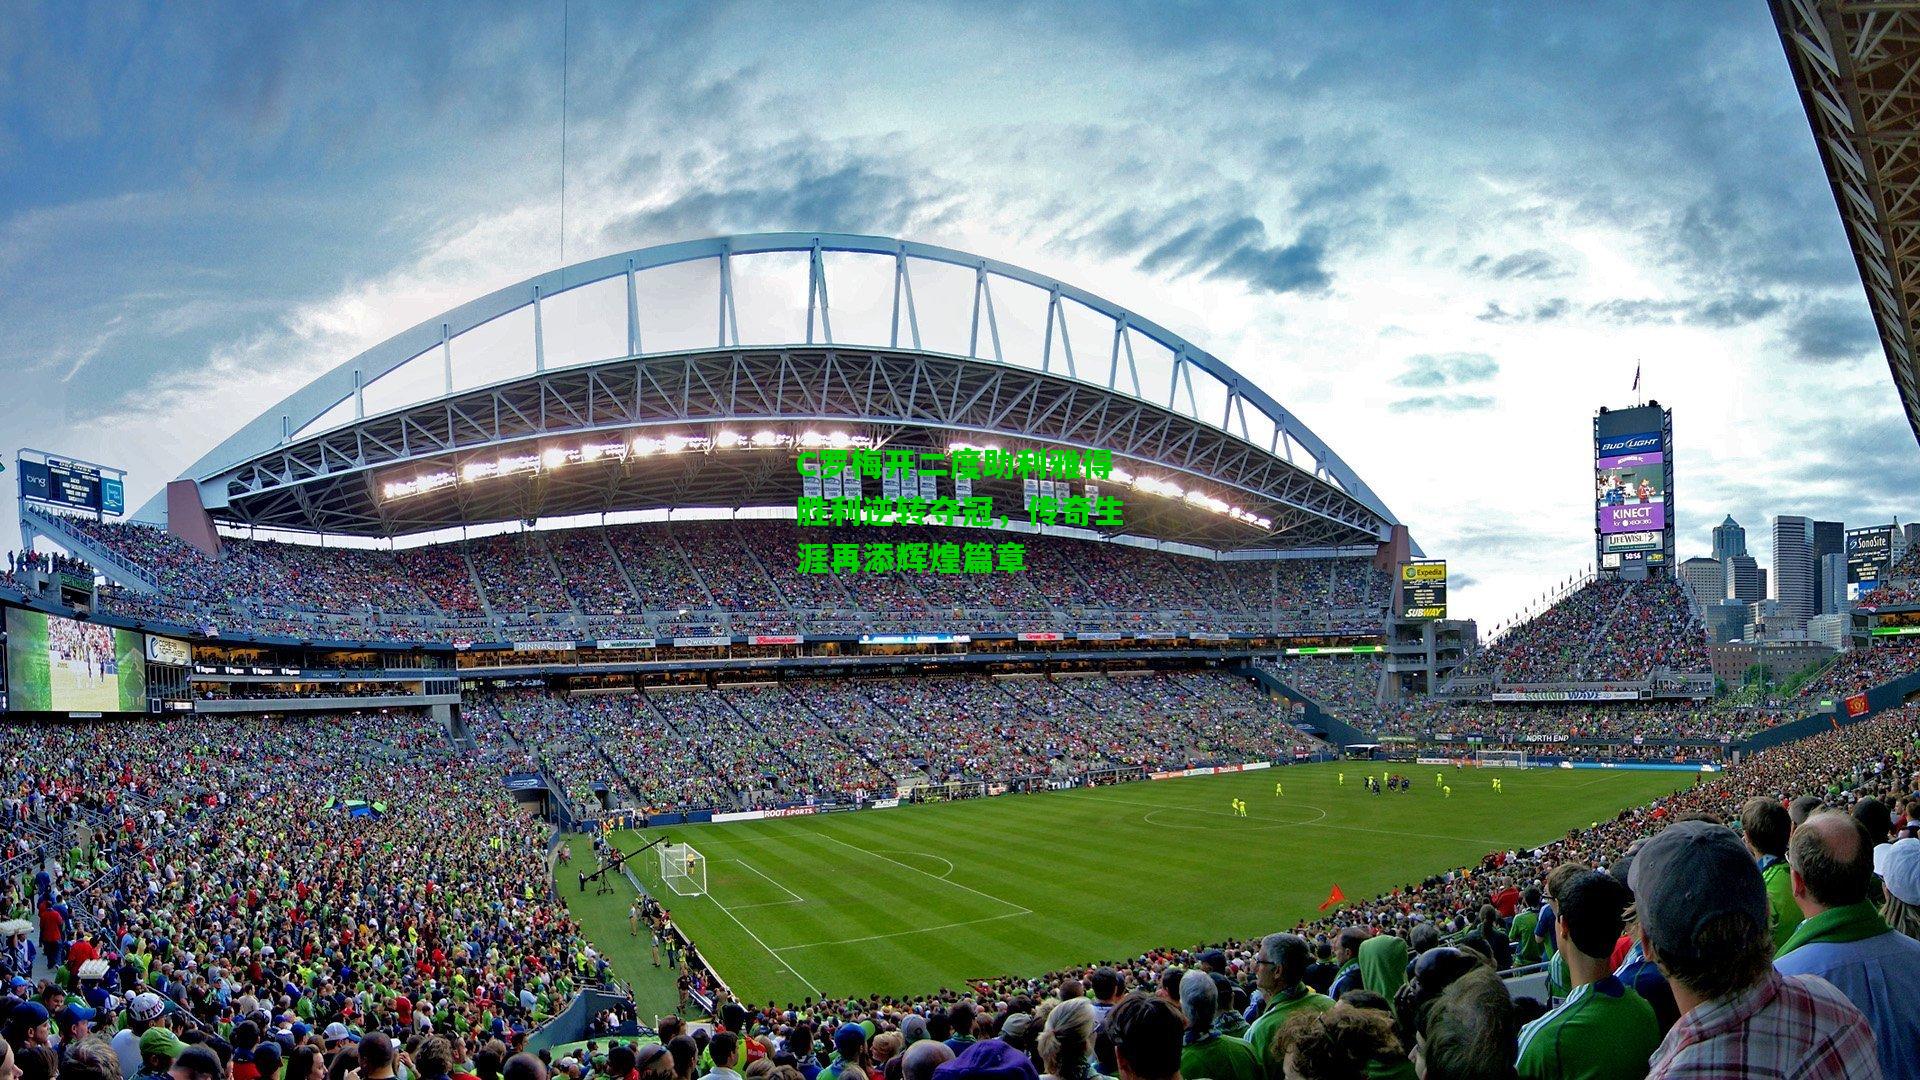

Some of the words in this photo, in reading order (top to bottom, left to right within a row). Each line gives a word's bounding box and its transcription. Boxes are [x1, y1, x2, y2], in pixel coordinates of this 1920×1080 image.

[1602, 442, 1625, 451] BUD
[1628, 438, 1659, 447] LIGHT
[26, 474, 46, 487] bing
[1613, 507, 1653, 520] KINECT
[1858, 535, 1886, 549] SonoSite
[1405, 608, 1445, 618] SUBWAY
[518, 642, 565, 651] PINNACLE
[1526, 734, 1551, 742] NORTH
[1553, 734, 1569, 742] END
[764, 808, 786, 818] ROOT
[786, 808, 813, 816] SPORTS
